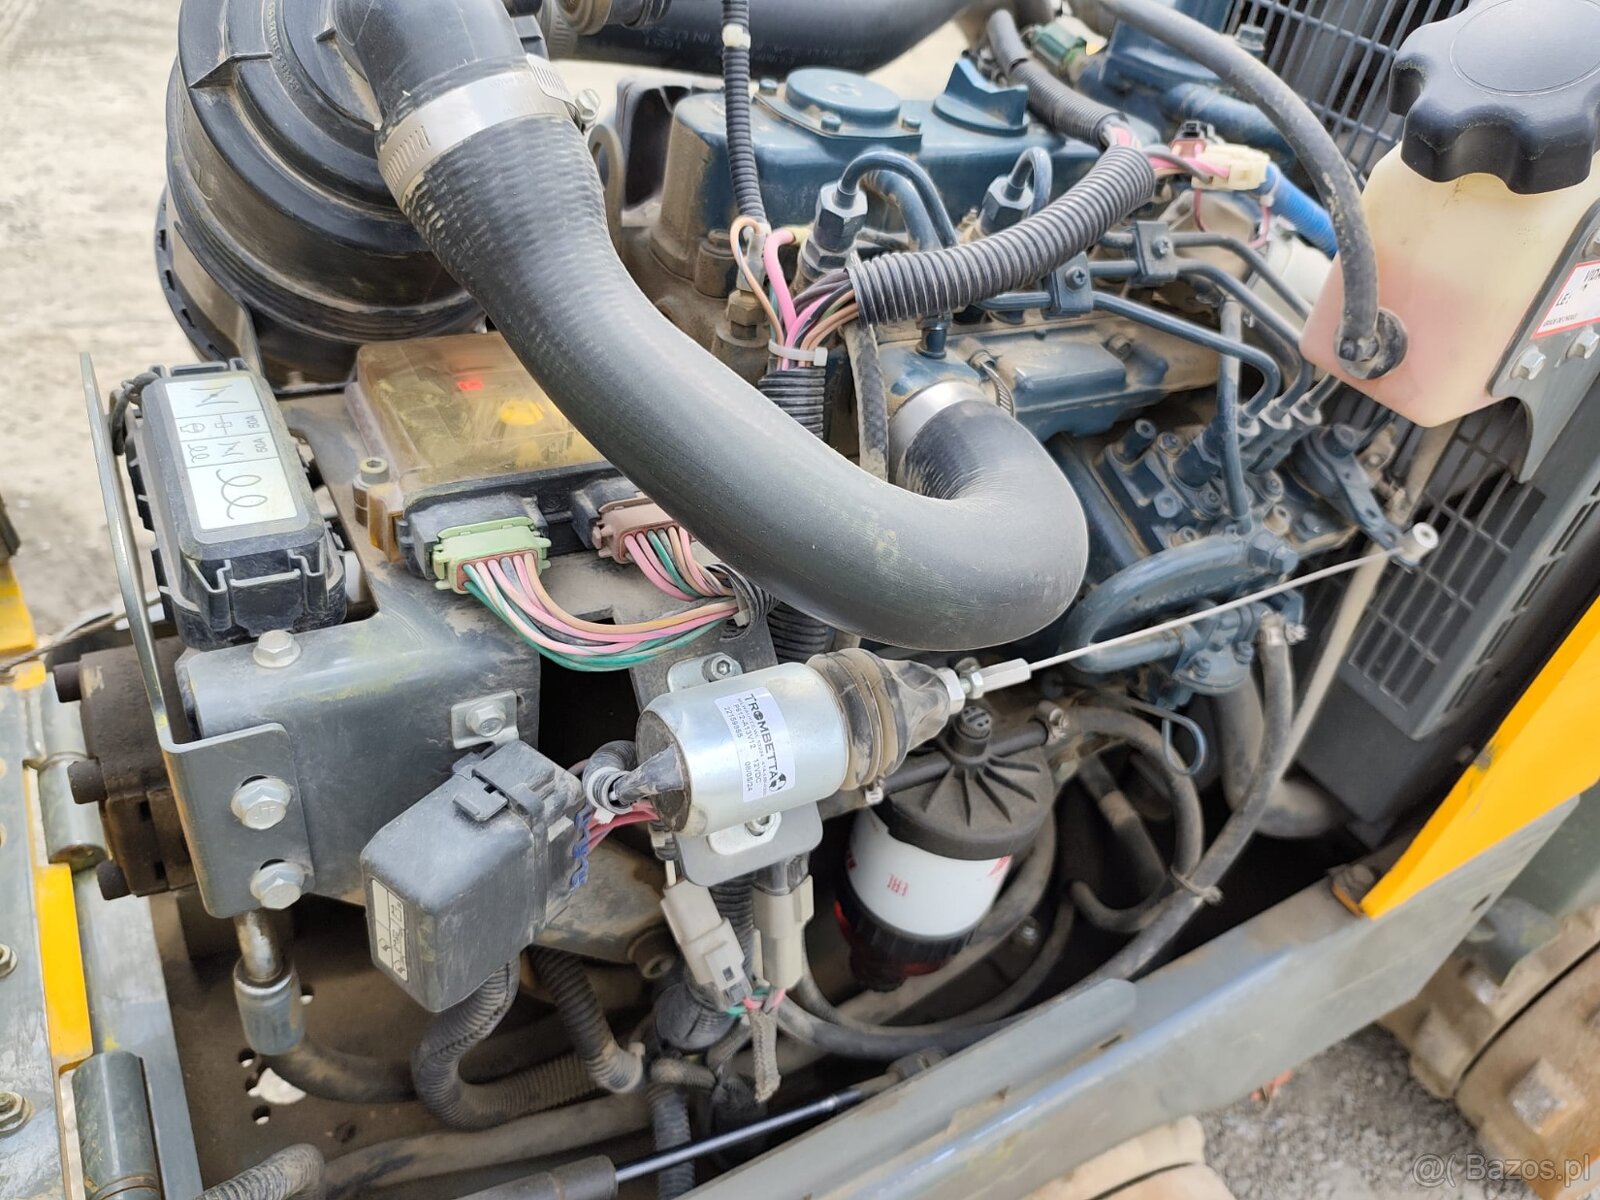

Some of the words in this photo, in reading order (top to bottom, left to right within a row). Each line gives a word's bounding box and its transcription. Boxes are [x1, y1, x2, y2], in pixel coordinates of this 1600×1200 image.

[245, 415, 260, 429] 50A
[254, 437, 268, 453] 50A
[744, 693, 778, 780] TROMBETTA
[753, 758, 762, 784] 12VDC
